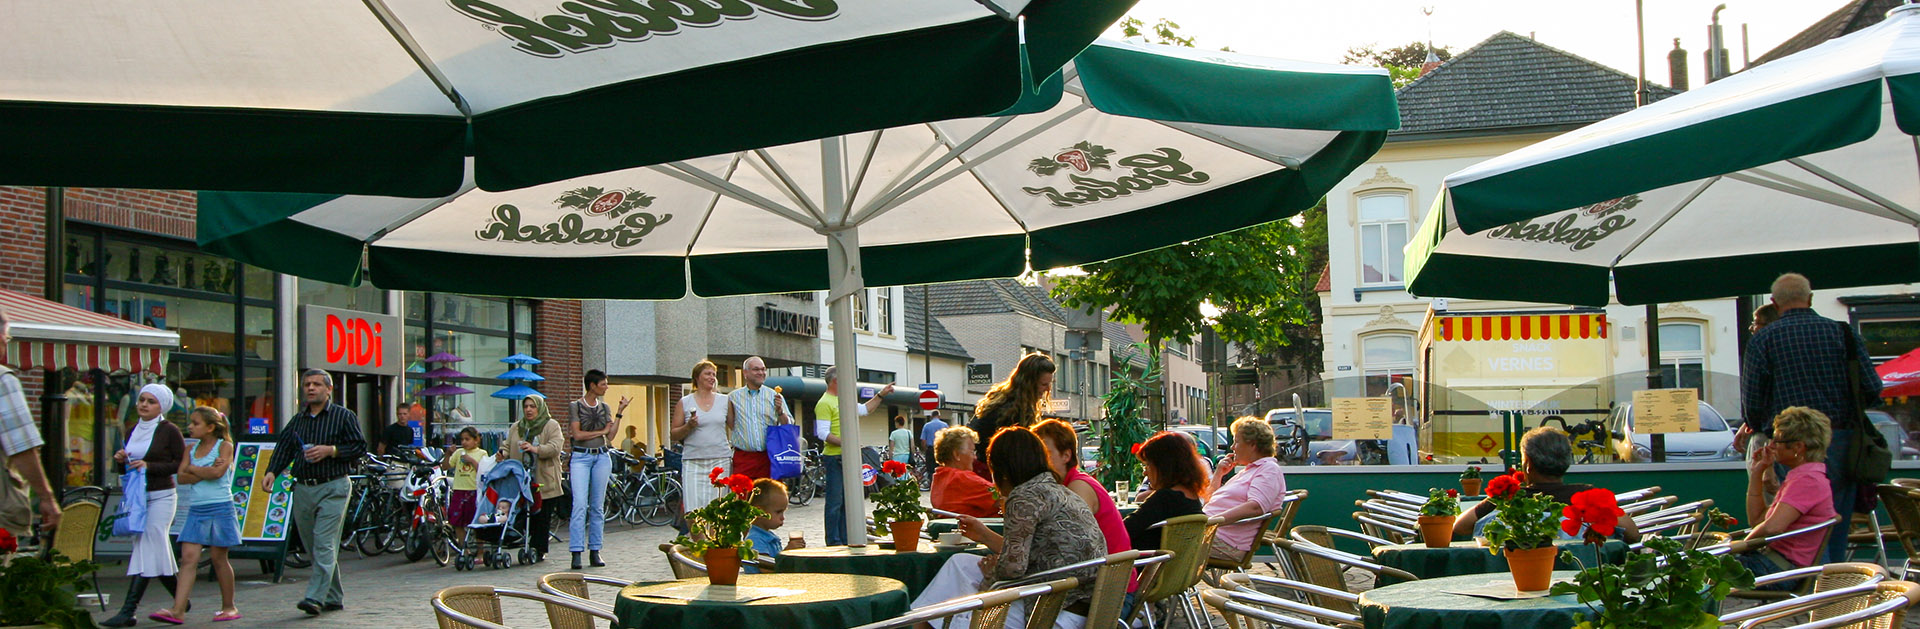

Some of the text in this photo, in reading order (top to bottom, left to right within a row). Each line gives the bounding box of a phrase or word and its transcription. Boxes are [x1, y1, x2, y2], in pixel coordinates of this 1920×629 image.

[326, 314, 383, 368] DiDi
[1512, 343, 1553, 353] SNACK
[1488, 357, 1554, 372] VERNES
